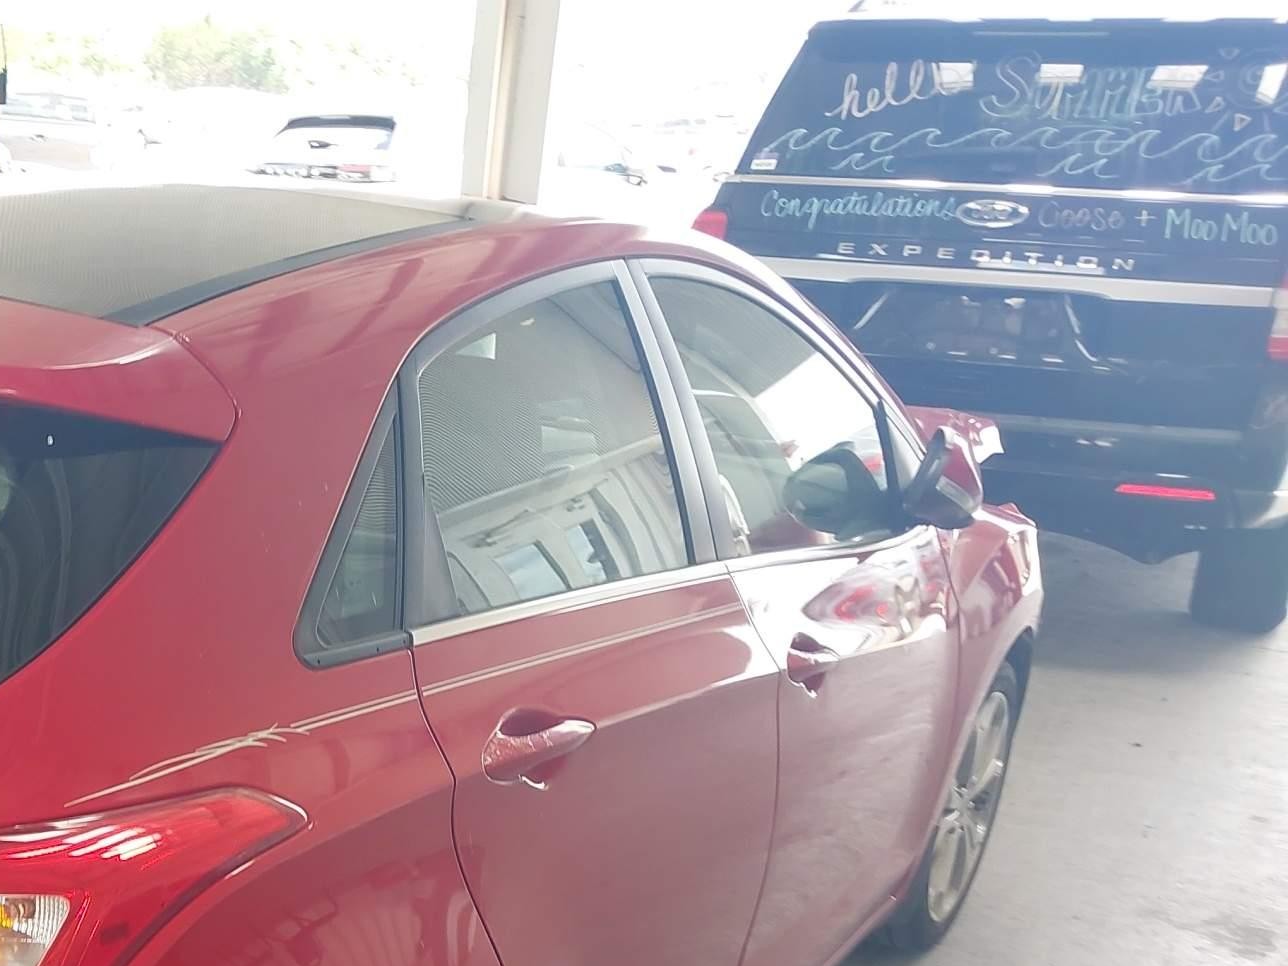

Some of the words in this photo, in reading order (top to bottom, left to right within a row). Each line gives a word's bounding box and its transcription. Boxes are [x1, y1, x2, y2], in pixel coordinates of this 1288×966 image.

[760, 189, 958, 230] Congratulations
[1038, 200, 1126, 231] Goose
[836, 241, 1136, 272] EXPEDITION
